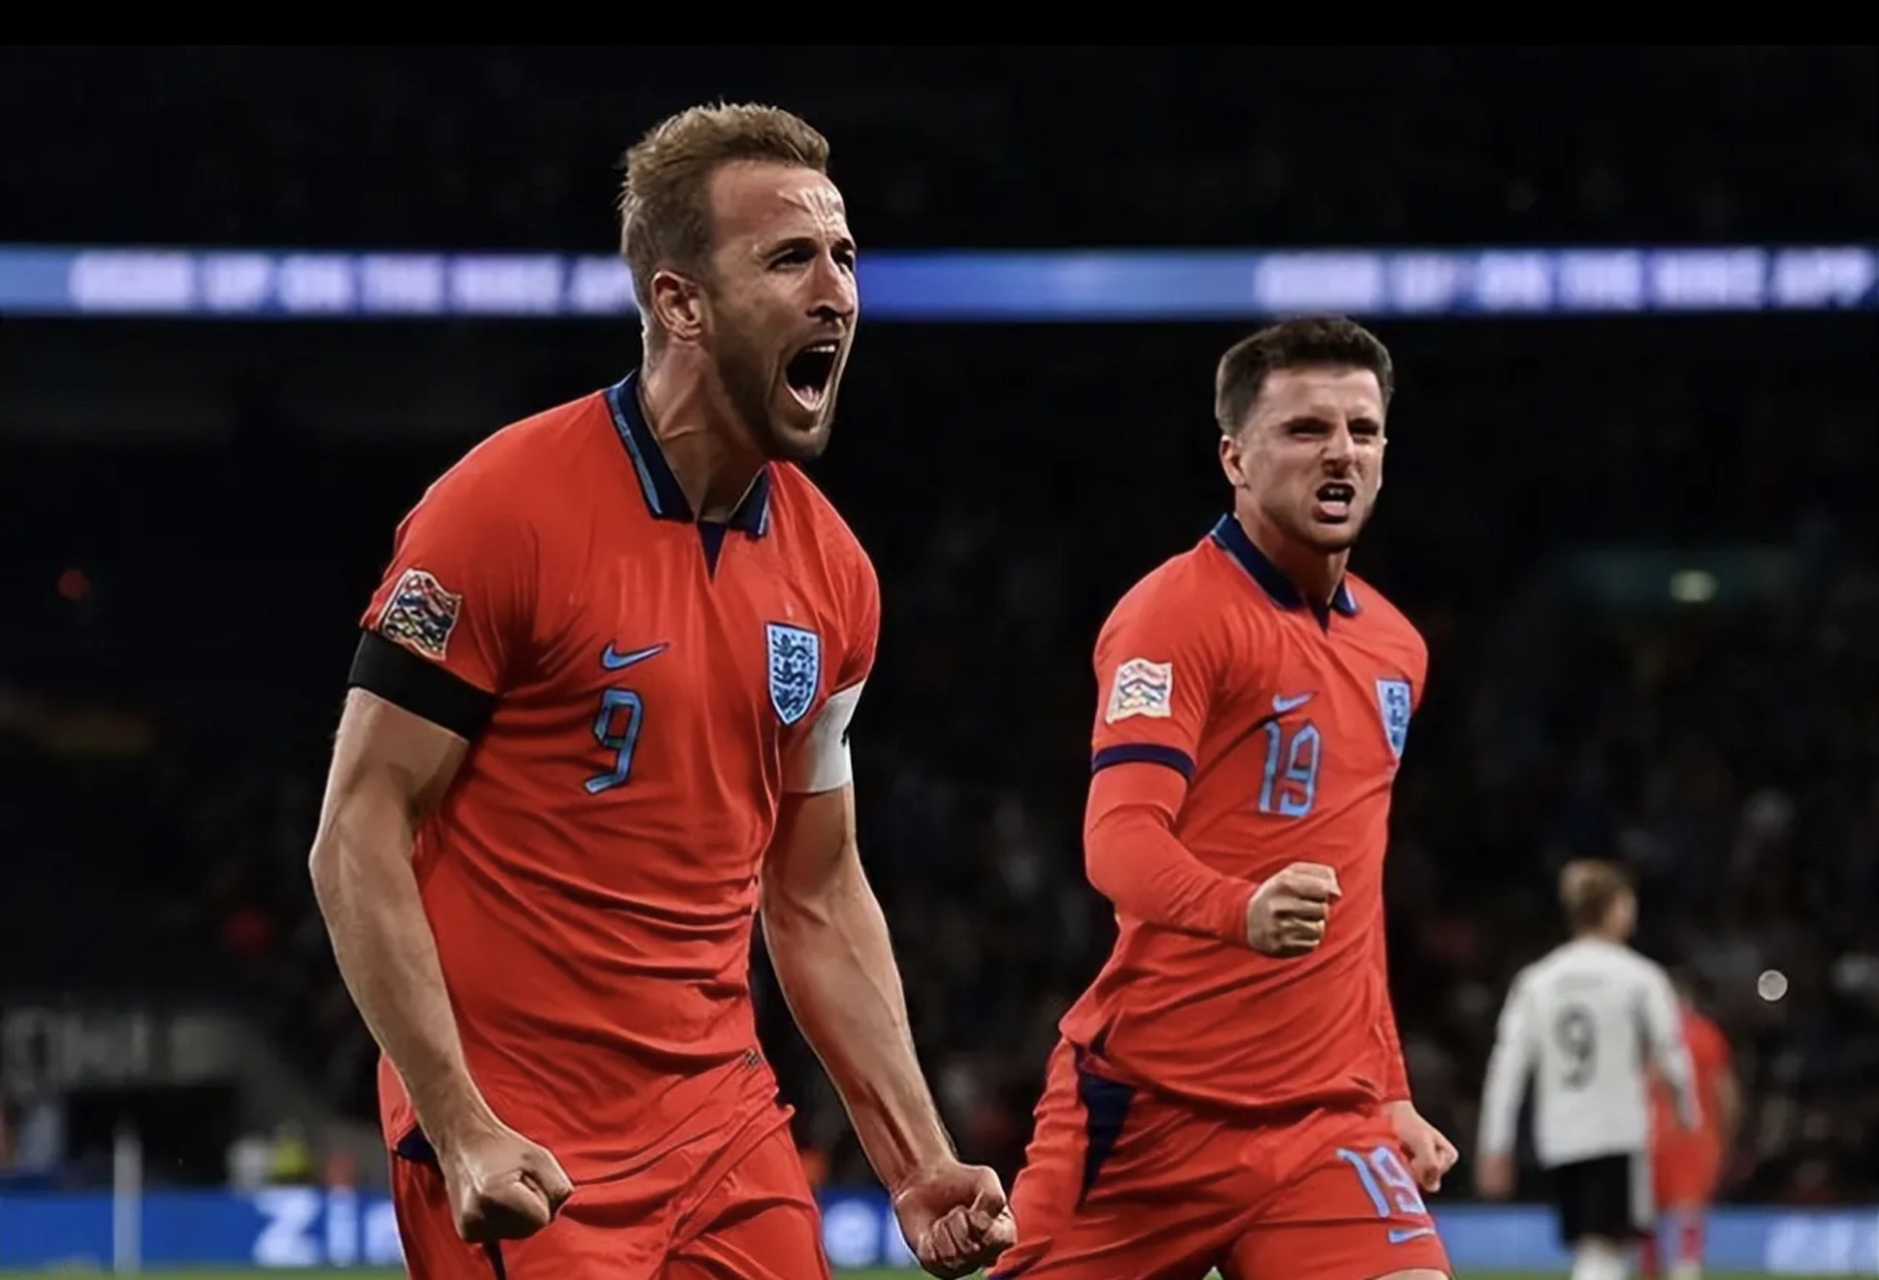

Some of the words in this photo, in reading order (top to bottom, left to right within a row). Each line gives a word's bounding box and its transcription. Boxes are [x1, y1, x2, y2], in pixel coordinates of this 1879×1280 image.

[584, 688, 643, 793] 9
[1259, 719, 1321, 818] 19
[1553, 1003, 1597, 1092] 9
[1336, 1146, 1427, 1217] 19
